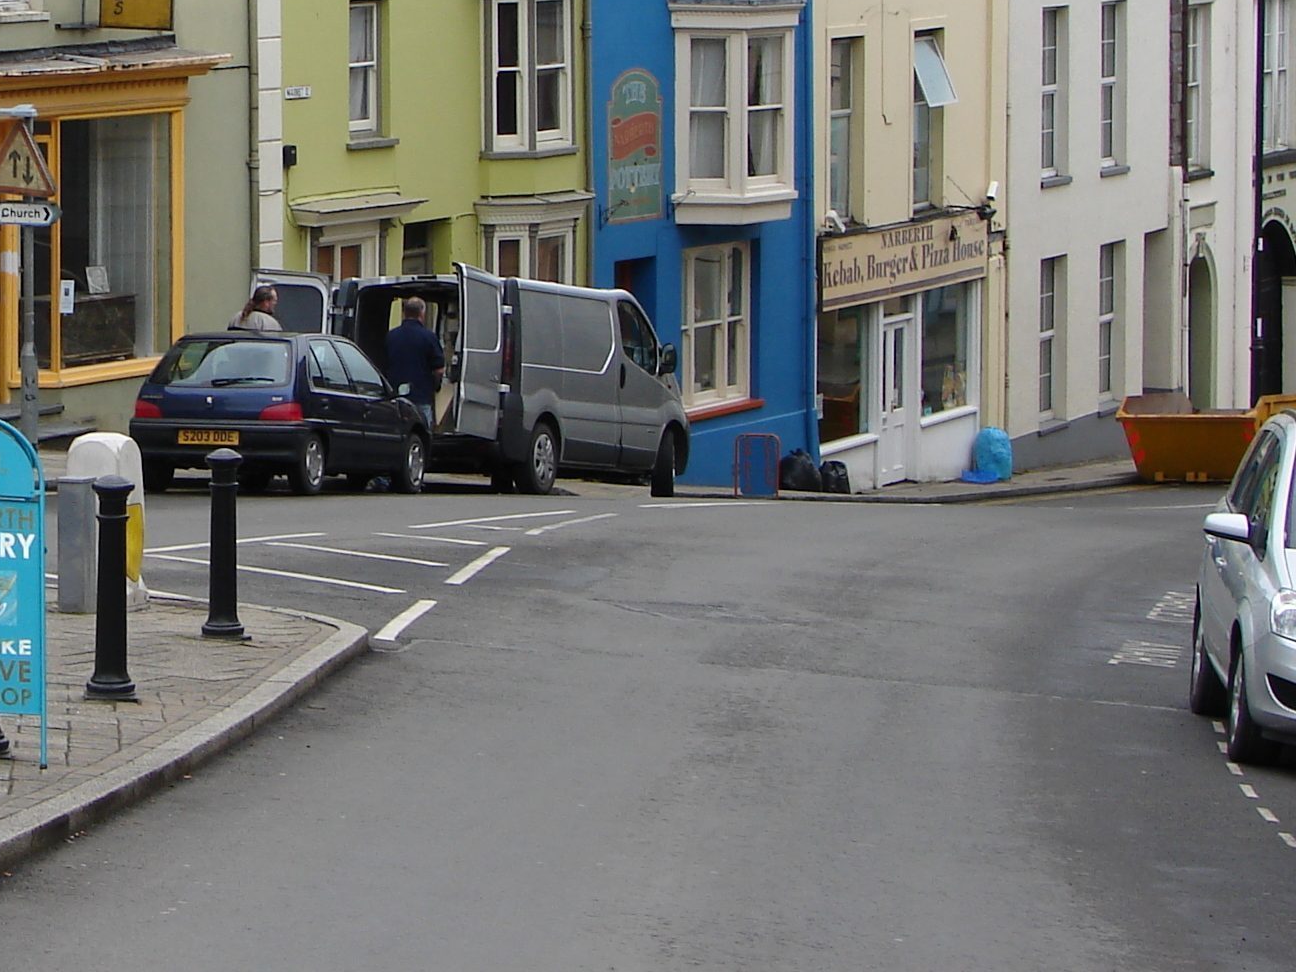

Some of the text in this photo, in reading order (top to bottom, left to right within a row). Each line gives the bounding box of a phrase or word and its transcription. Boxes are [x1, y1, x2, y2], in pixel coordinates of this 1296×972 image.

[1, 208, 41, 218] Church
[880, 225, 934, 249] NARBERTH
[867, 254, 909, 284] Burger
[909, 250, 918, 272] &
[921, 242, 950, 270] Pizza
[953, 236, 985, 262] House
[183, 430, 210, 442] S203
